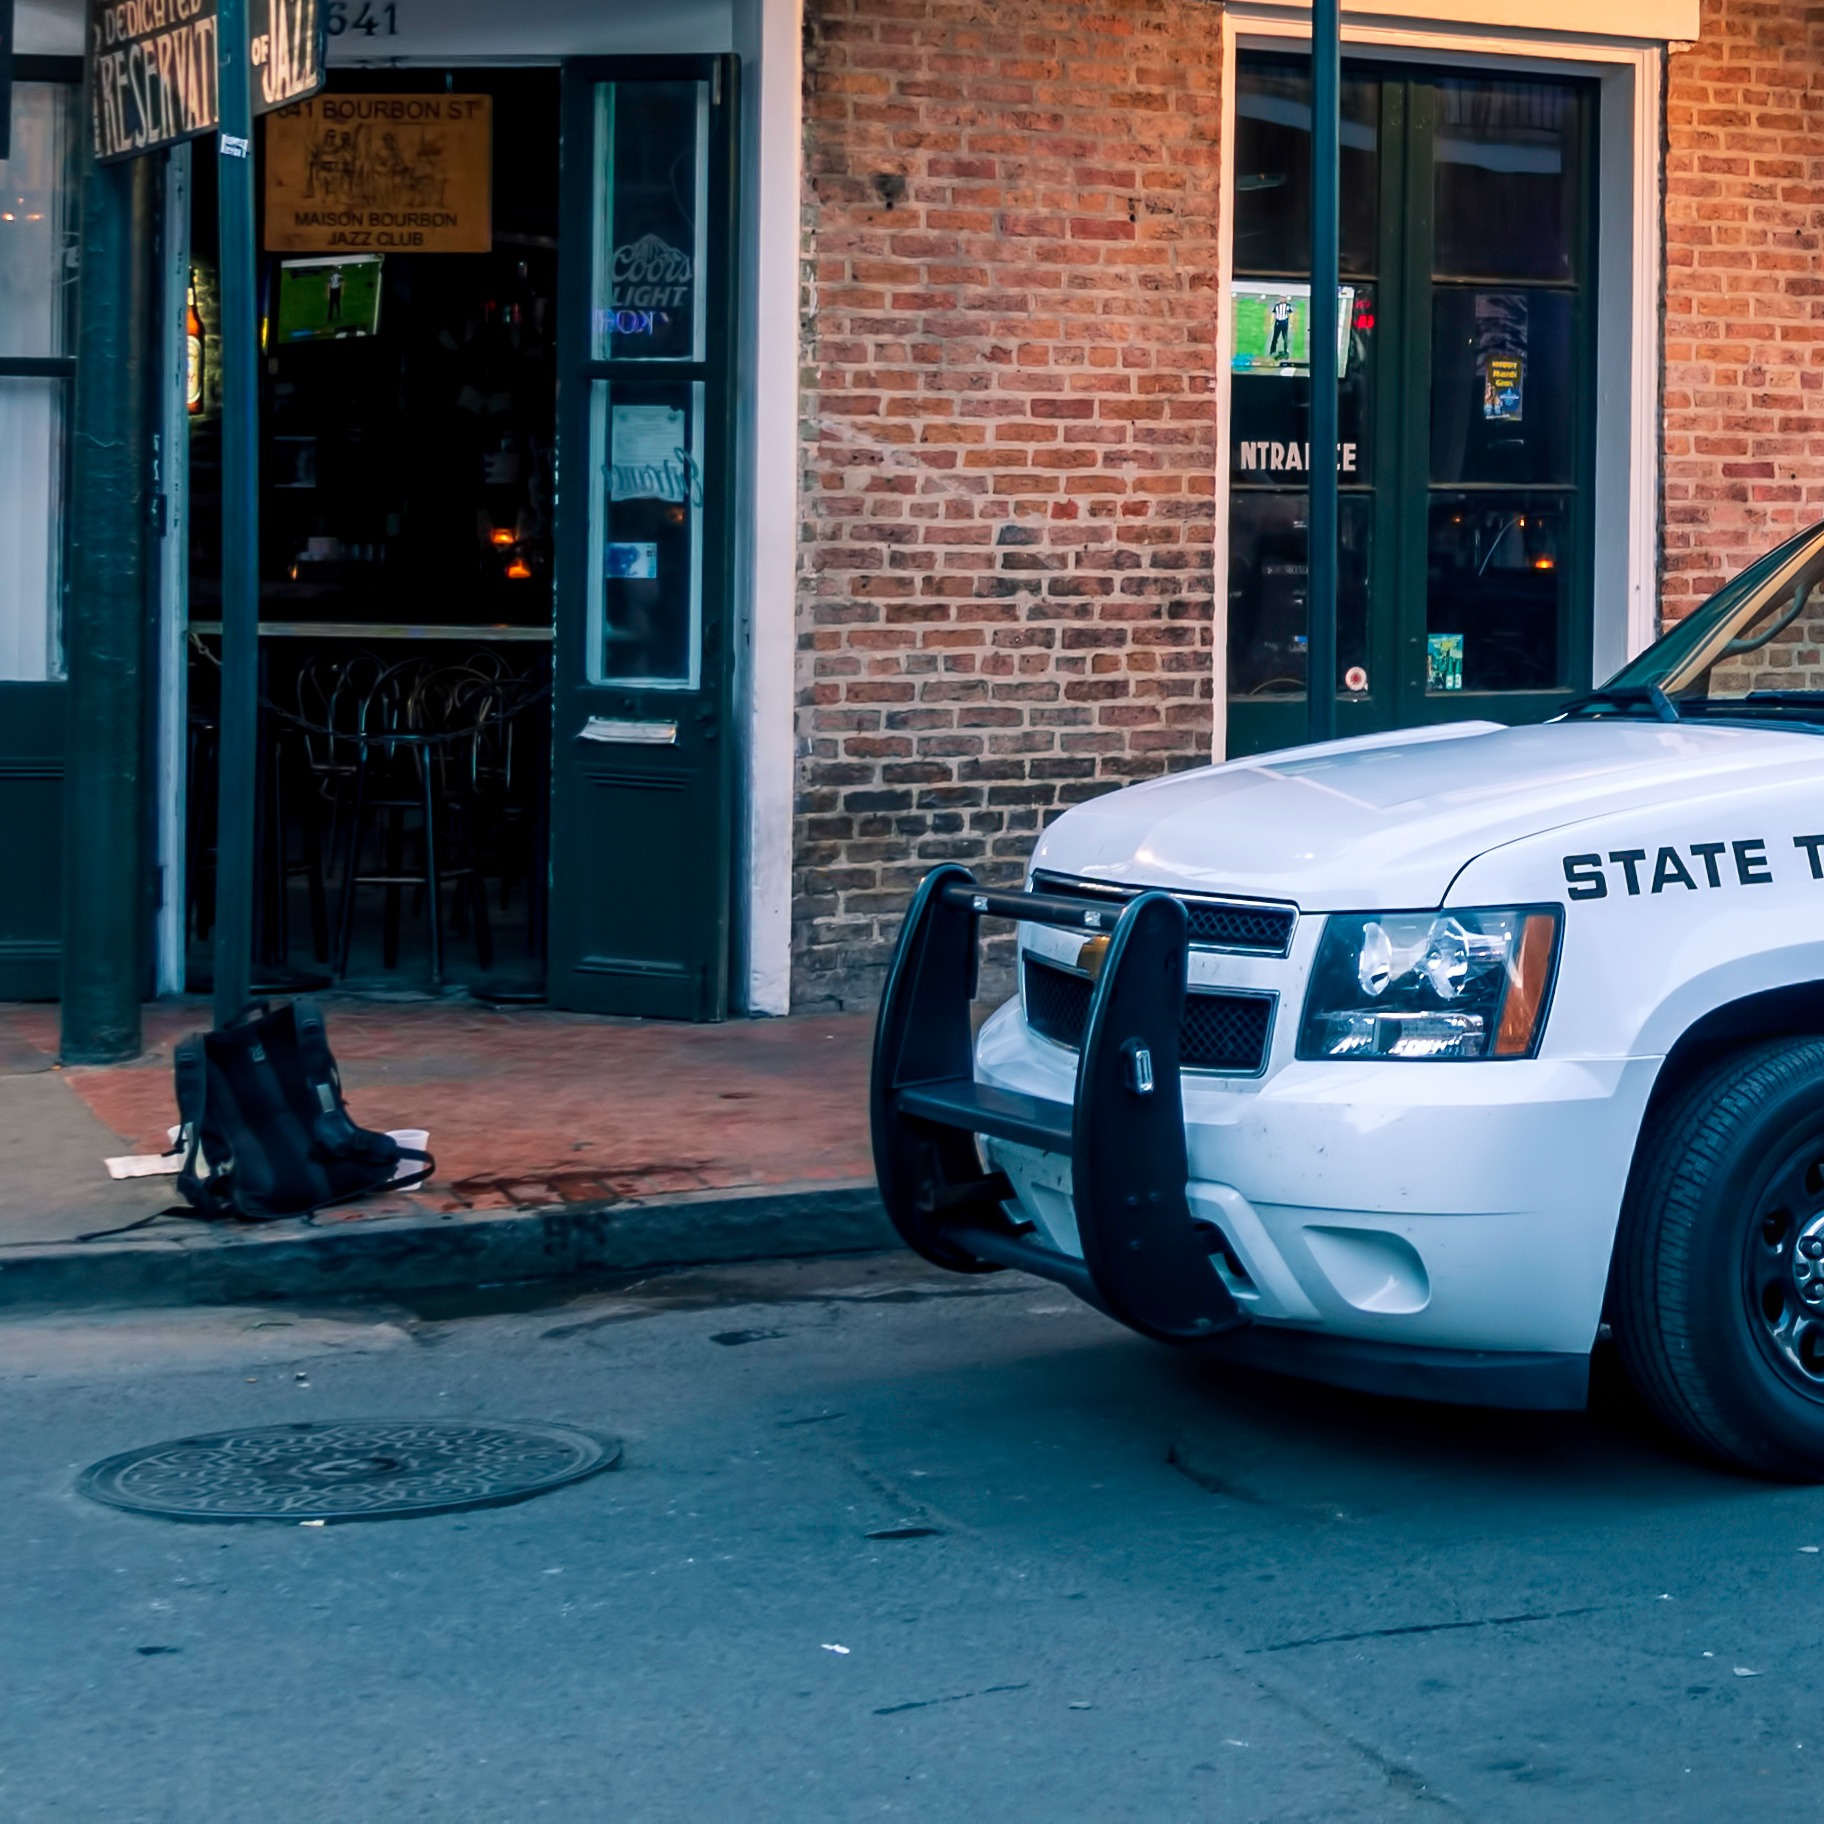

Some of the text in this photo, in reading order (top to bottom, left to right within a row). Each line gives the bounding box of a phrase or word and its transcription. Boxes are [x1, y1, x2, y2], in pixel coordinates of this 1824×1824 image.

[327, 0, 399, 37] 641
[252, 34, 271, 66] OF
[323, 101, 440, 119] BOURBON
[448, 101, 477, 119] ST
[294, 212, 458, 227] MAISON BOURBON
[326, 231, 424, 247] JAZZ CLUB
[612, 244, 693, 284] Coors
[612, 286, 689, 307] LIGHT
[1240, 440, 1357, 471] NTRAE
[1562, 838, 1773, 900] STATE
